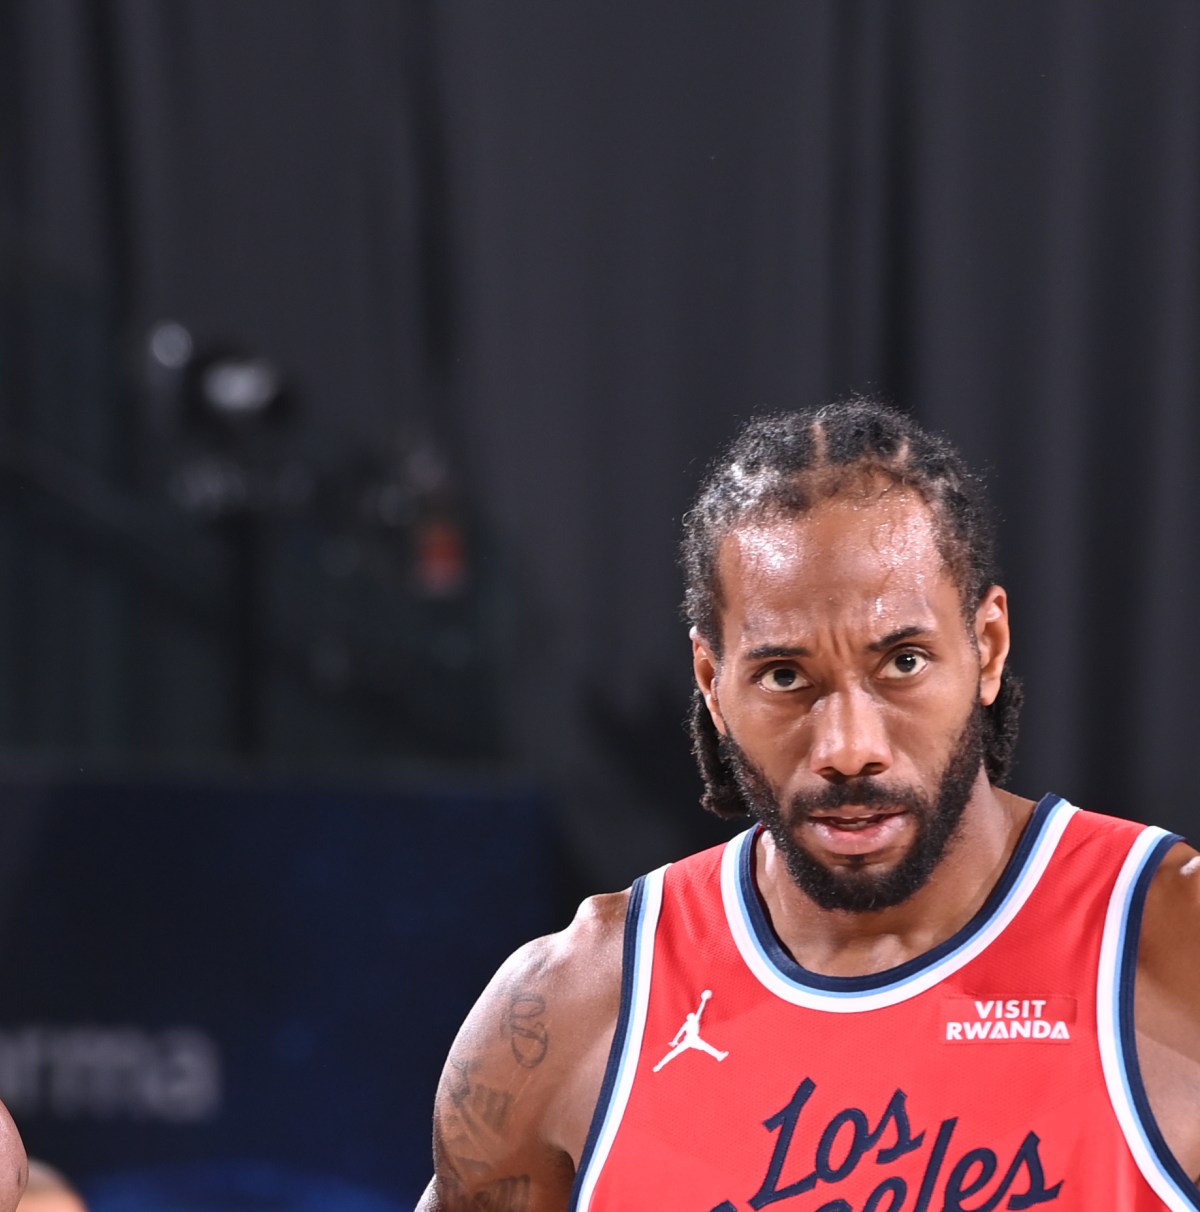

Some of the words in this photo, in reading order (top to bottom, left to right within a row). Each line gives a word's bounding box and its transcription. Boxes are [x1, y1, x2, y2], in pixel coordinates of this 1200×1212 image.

[974, 999, 1047, 1019] VISIT
[946, 1020, 1070, 1040] RWANDA
[748, 1076, 926, 1212] Los
